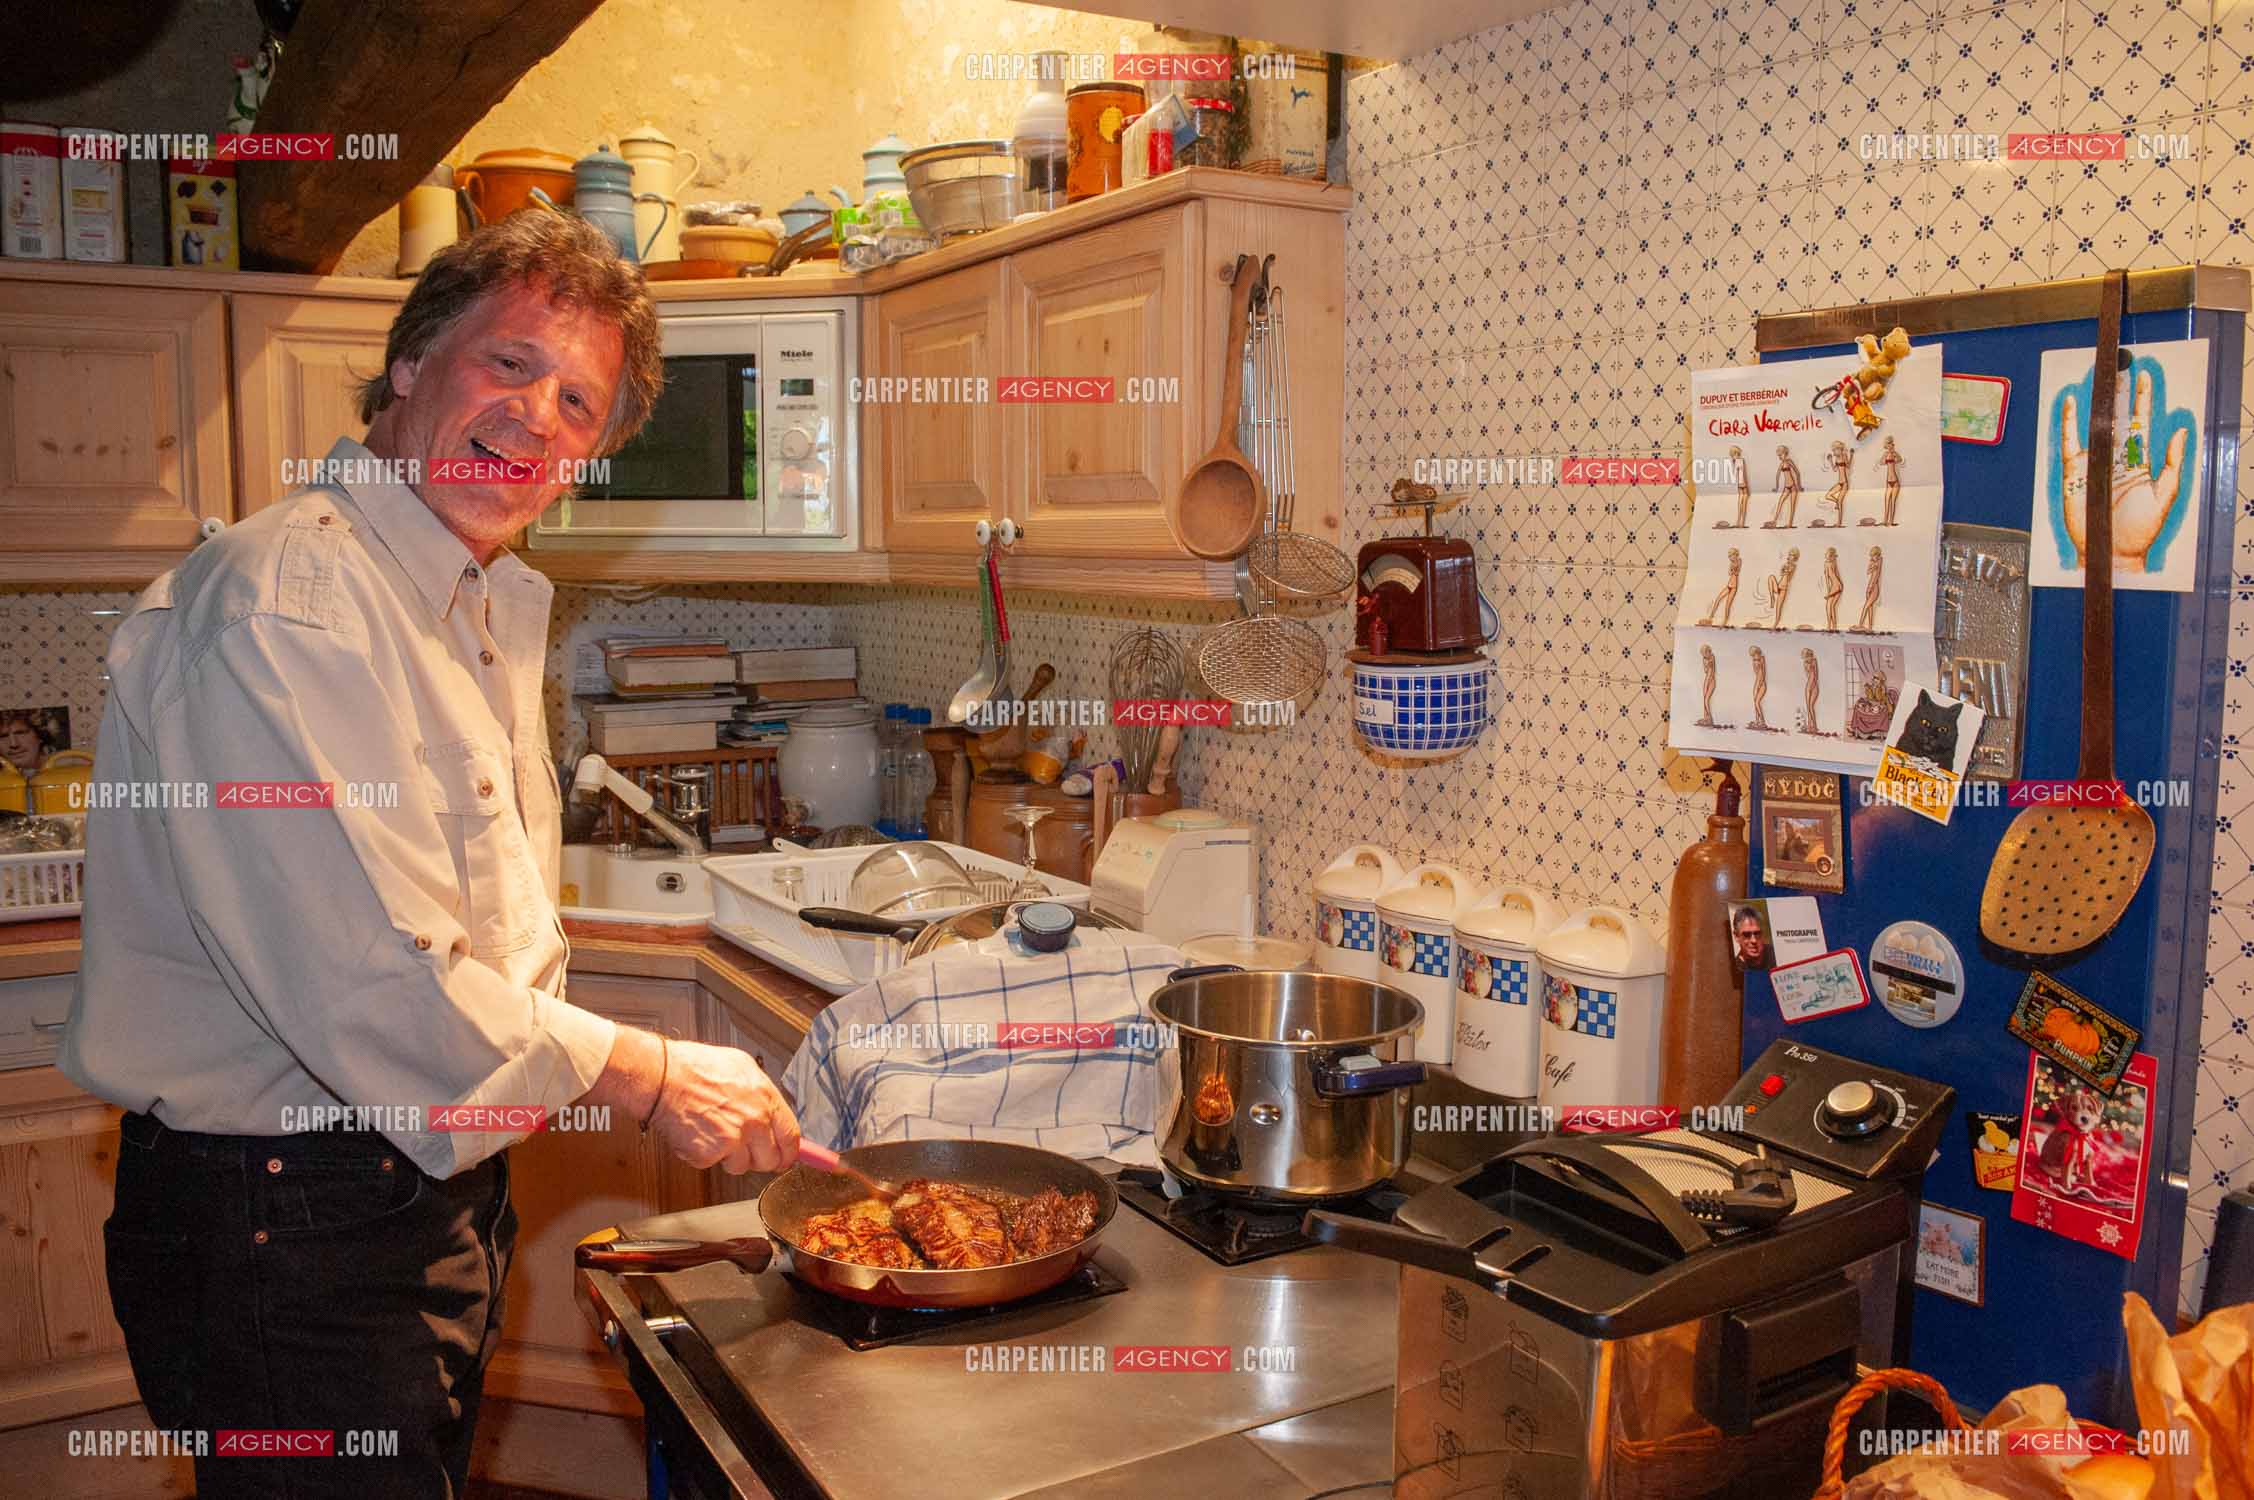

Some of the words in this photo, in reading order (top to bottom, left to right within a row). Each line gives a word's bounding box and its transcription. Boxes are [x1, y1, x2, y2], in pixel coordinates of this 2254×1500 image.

[780, 350, 814, 358] Miele
[1700, 393, 1728, 405] DUPUY
[1728, 392, 1739, 402] ET
[1776, 928, 1818, 937] PHOTOGRAPHE
[2053, 1039, 2094, 1073] PUMPKIN
[1544, 1054, 1576, 1088] Café
